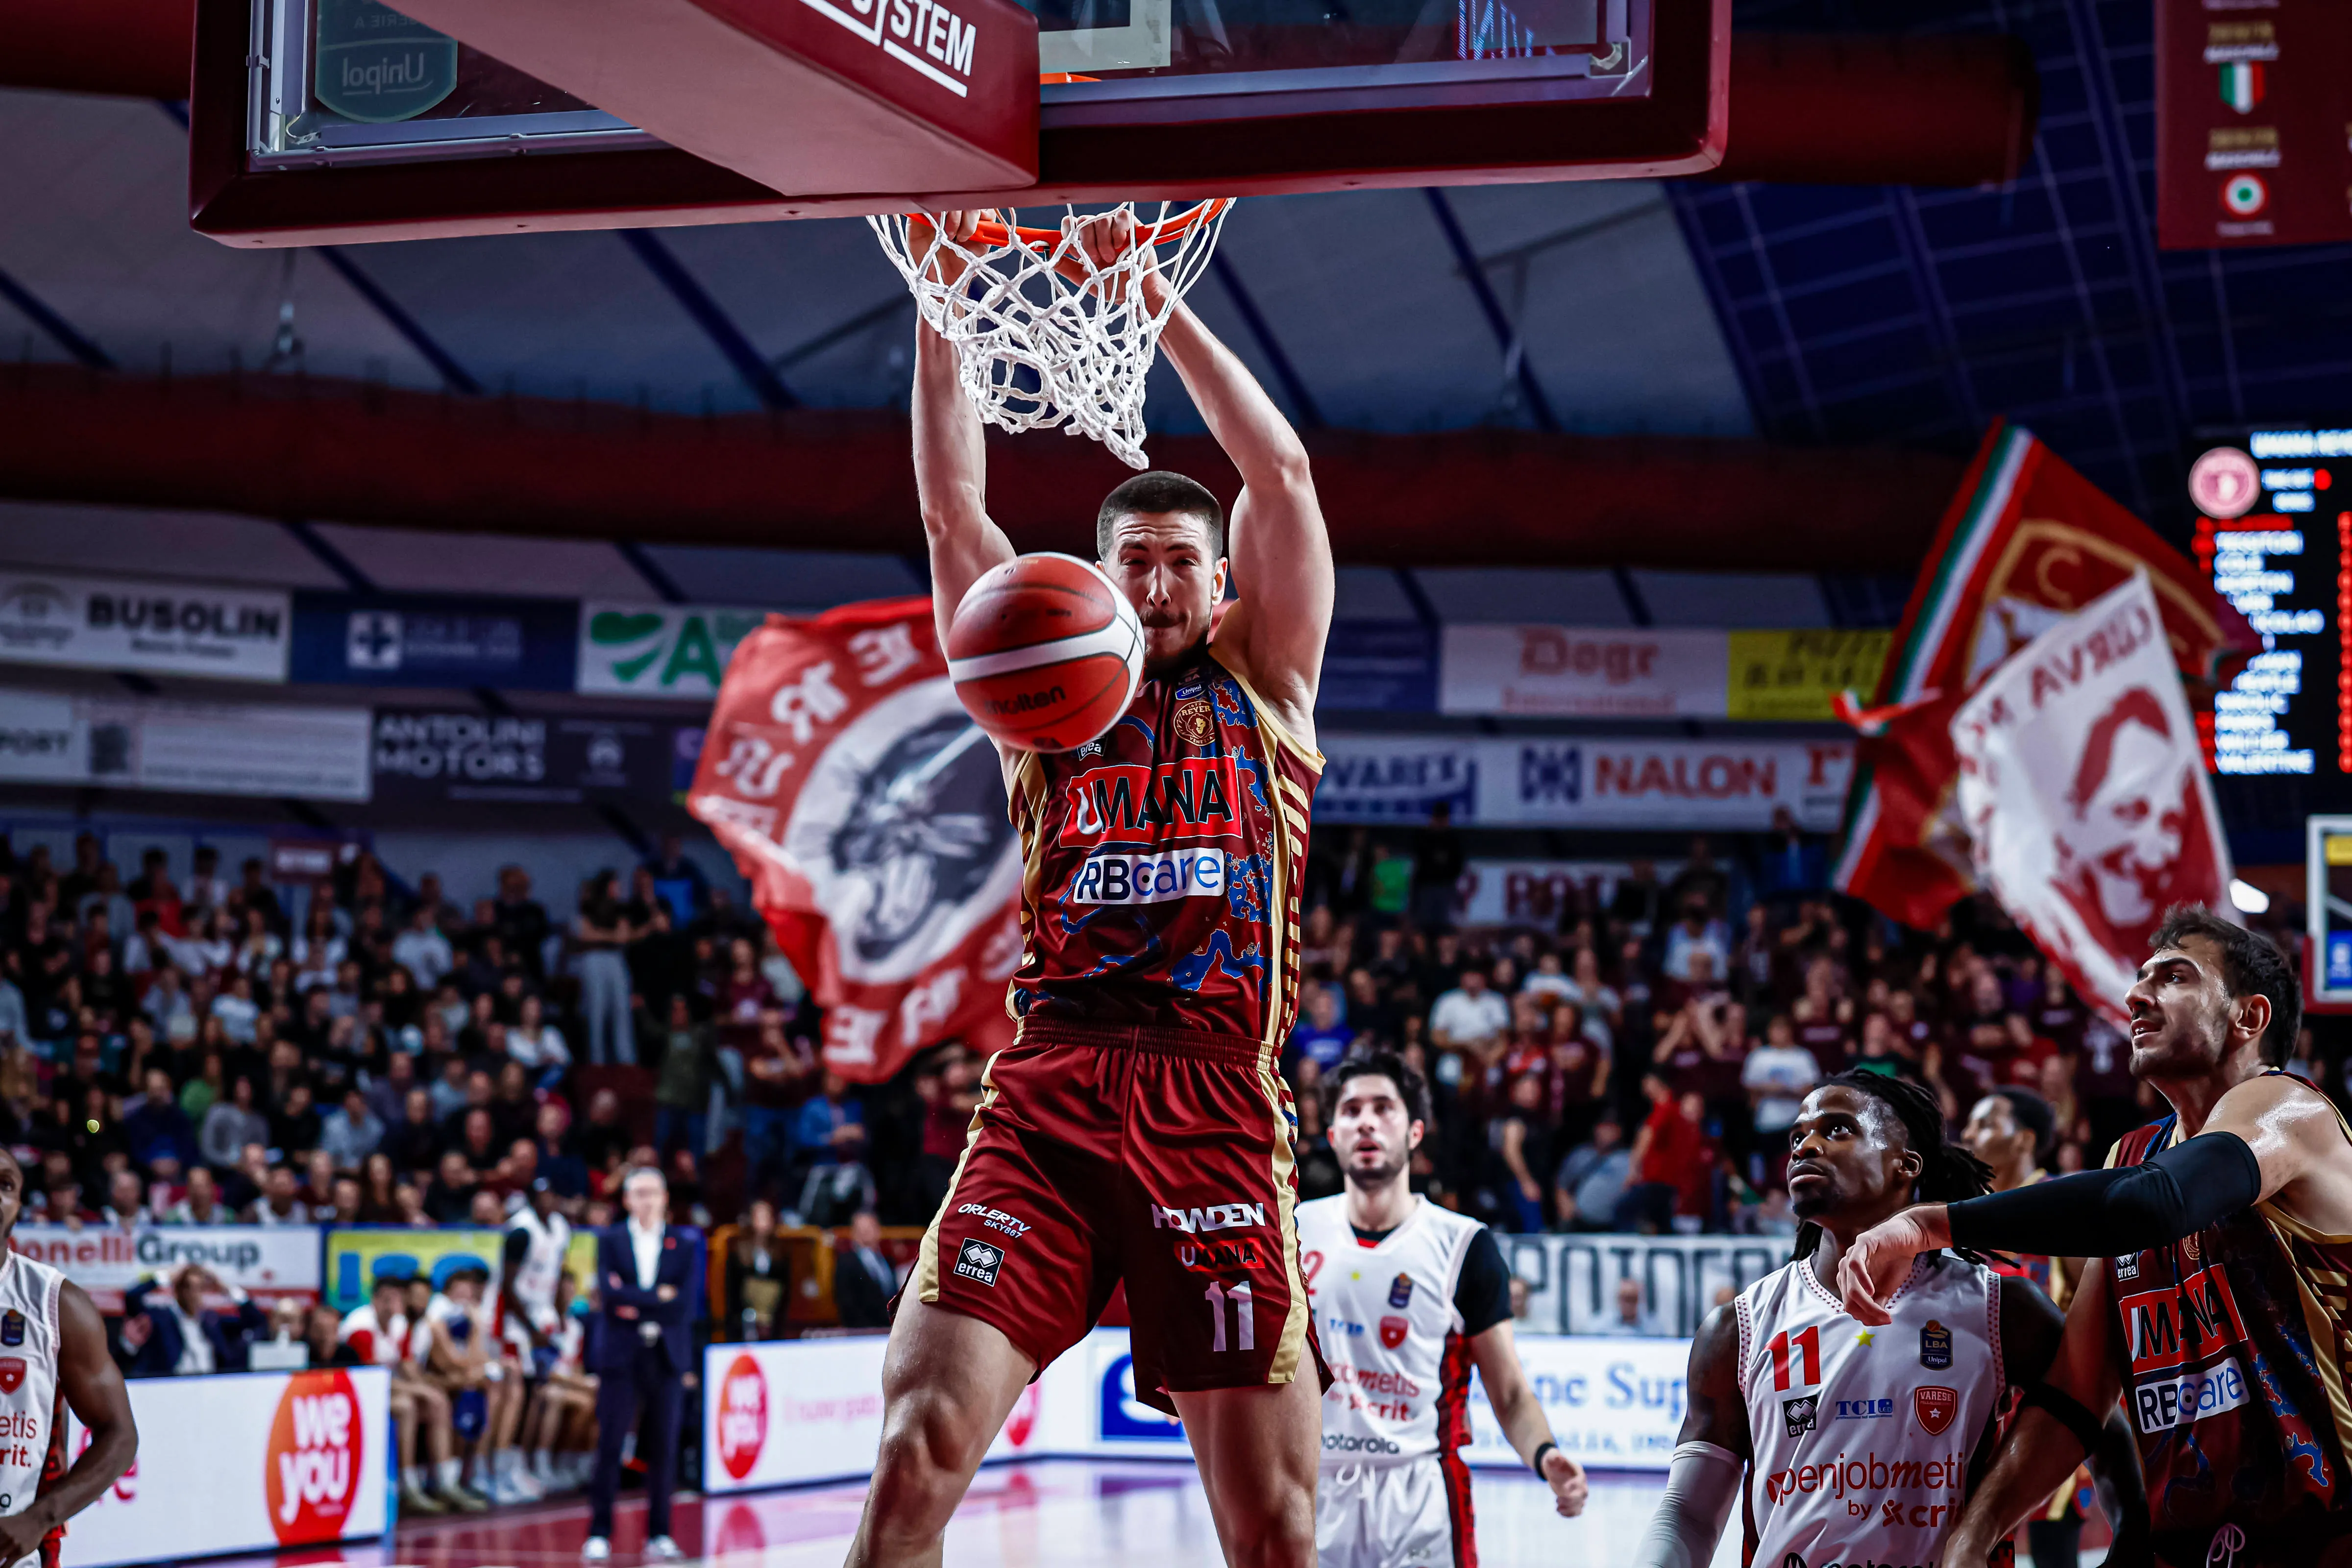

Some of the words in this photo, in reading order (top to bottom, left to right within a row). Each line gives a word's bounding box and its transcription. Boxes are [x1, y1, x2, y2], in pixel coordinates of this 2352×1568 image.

[86, 592, 282, 644] BUSOLIN
[984, 686, 1066, 715] molten
[1182, 684, 1202, 695] Unipol
[1181, 705, 1211, 716] REYER
[1594, 756, 1777, 799] NALON
[1077, 770, 1233, 835] UMANA
[1077, 856, 1221, 901] RBcare
[984, 1219, 1023, 1238] SKY867
[1152, 1203, 1266, 1234] HOWDEN
[1181, 1243, 1258, 1267] UMANA
[1205, 1280, 1254, 1352] 11
[1763, 1325, 1821, 1392] 11
[1925, 1340, 1948, 1349] LBA
[1928, 1356, 1947, 1364] Unipol
[1836, 1400, 1876, 1416] TCI
[1920, 1391, 1952, 1401] VARESE
[2137, 1367, 2244, 1430] RBcare
[293, 1393, 352, 1449] we
[279, 1445, 351, 1525] you
[1848, 1499, 1872, 1521] by
